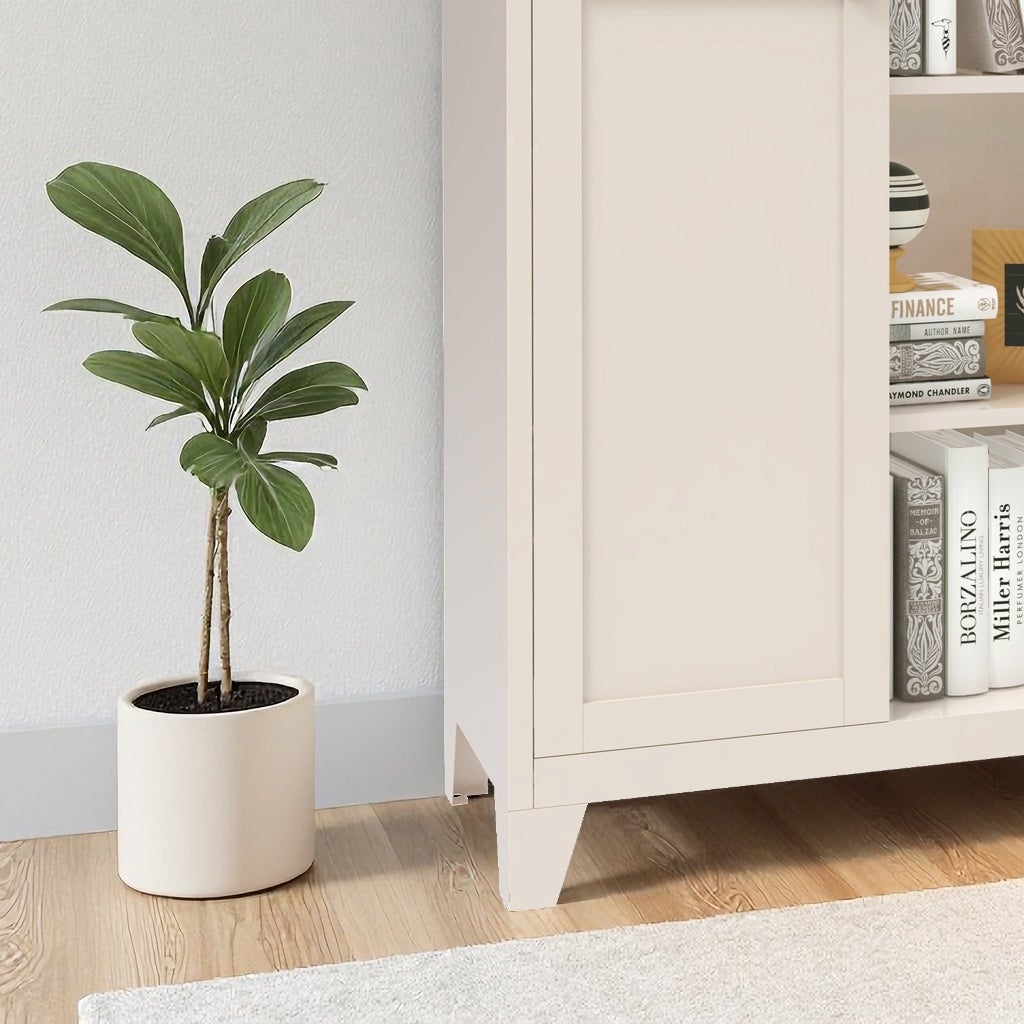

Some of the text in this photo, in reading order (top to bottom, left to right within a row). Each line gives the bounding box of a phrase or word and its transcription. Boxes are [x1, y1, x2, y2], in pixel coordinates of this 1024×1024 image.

[891, 297, 955, 319] FINANCE
[924, 326, 971, 337] AUTHOR NAME
[926, 387, 970, 397] CHANDLER
[909, 507, 939, 516] MEMOIR
[909, 527, 938, 536] BALZAC
[960, 510, 978, 646] BORZALINO
[993, 503, 1011, 642] Miller Harris
